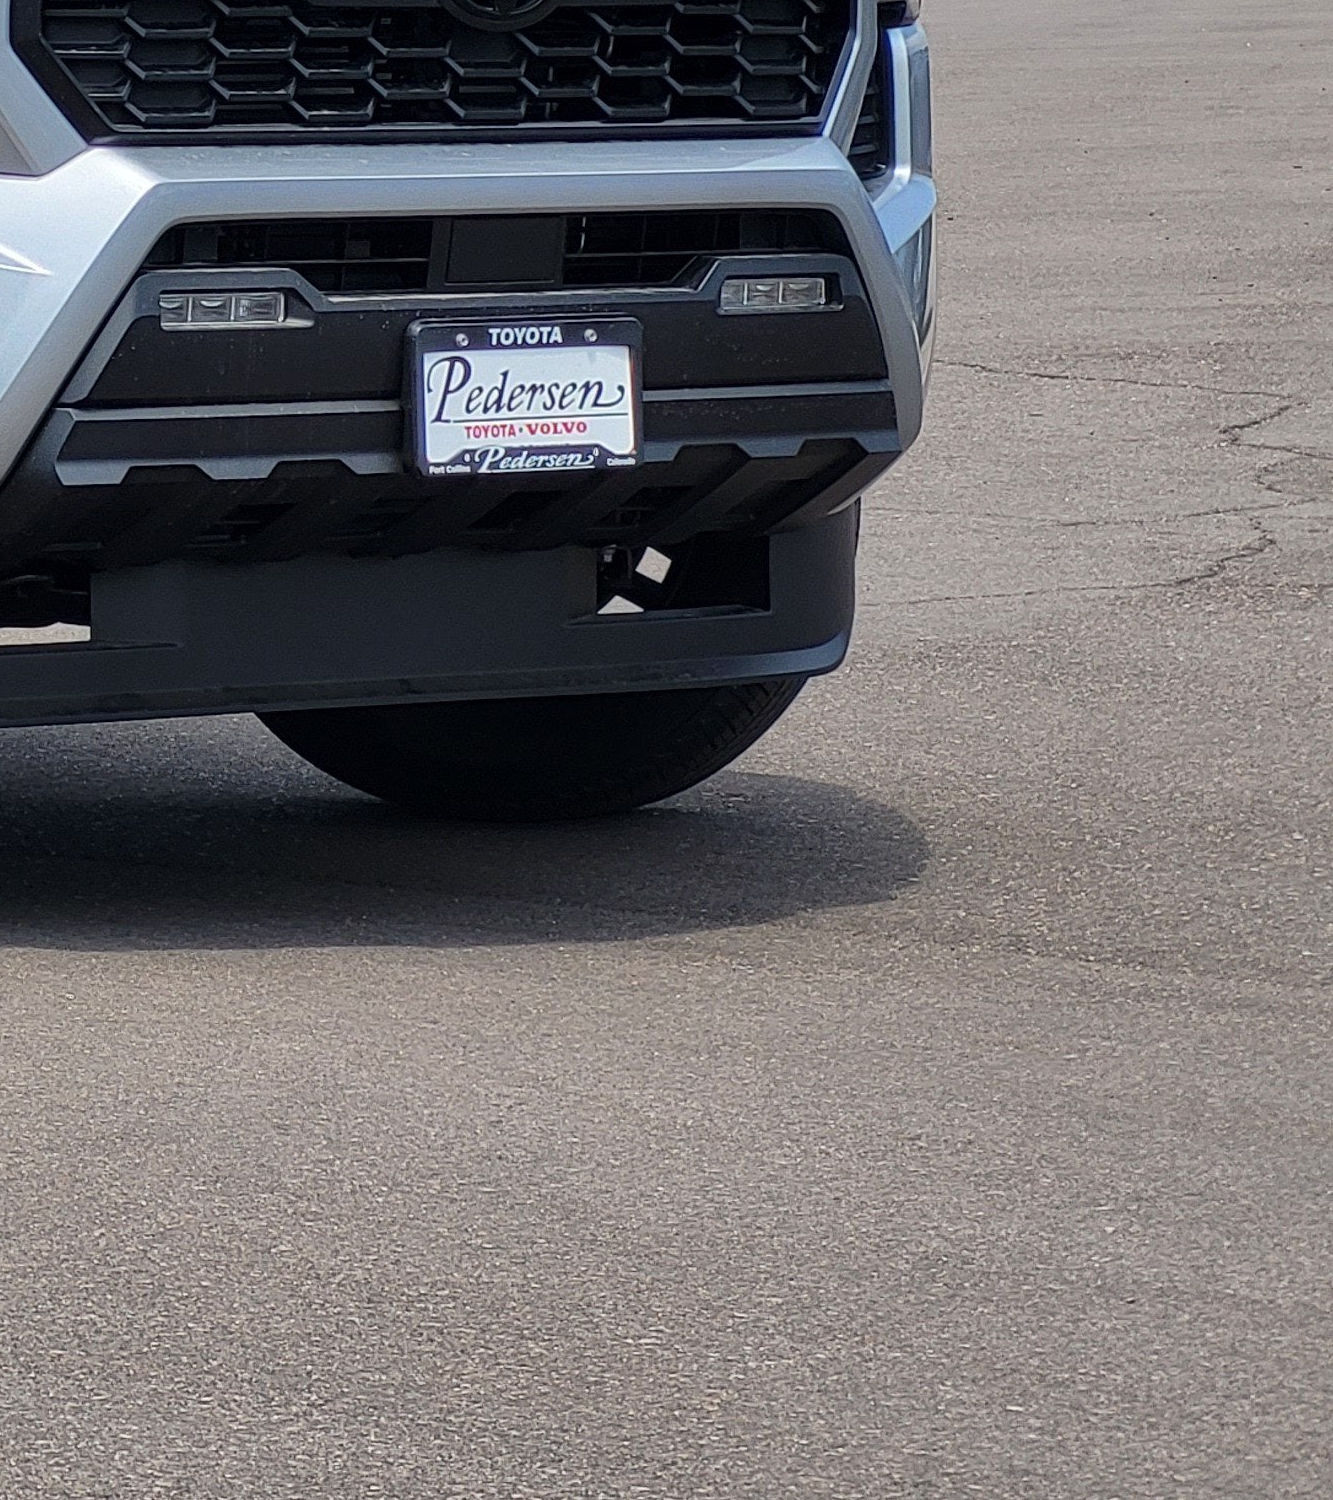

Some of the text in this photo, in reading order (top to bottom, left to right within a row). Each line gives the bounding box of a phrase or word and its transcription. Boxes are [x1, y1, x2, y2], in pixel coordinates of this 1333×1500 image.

[488, 326, 563, 346] TOYOTA
[427, 355, 625, 424] Pedersen
[464, 421, 588, 440] TOYOTA VOLVO
[474, 446, 595, 473] Pedersen
